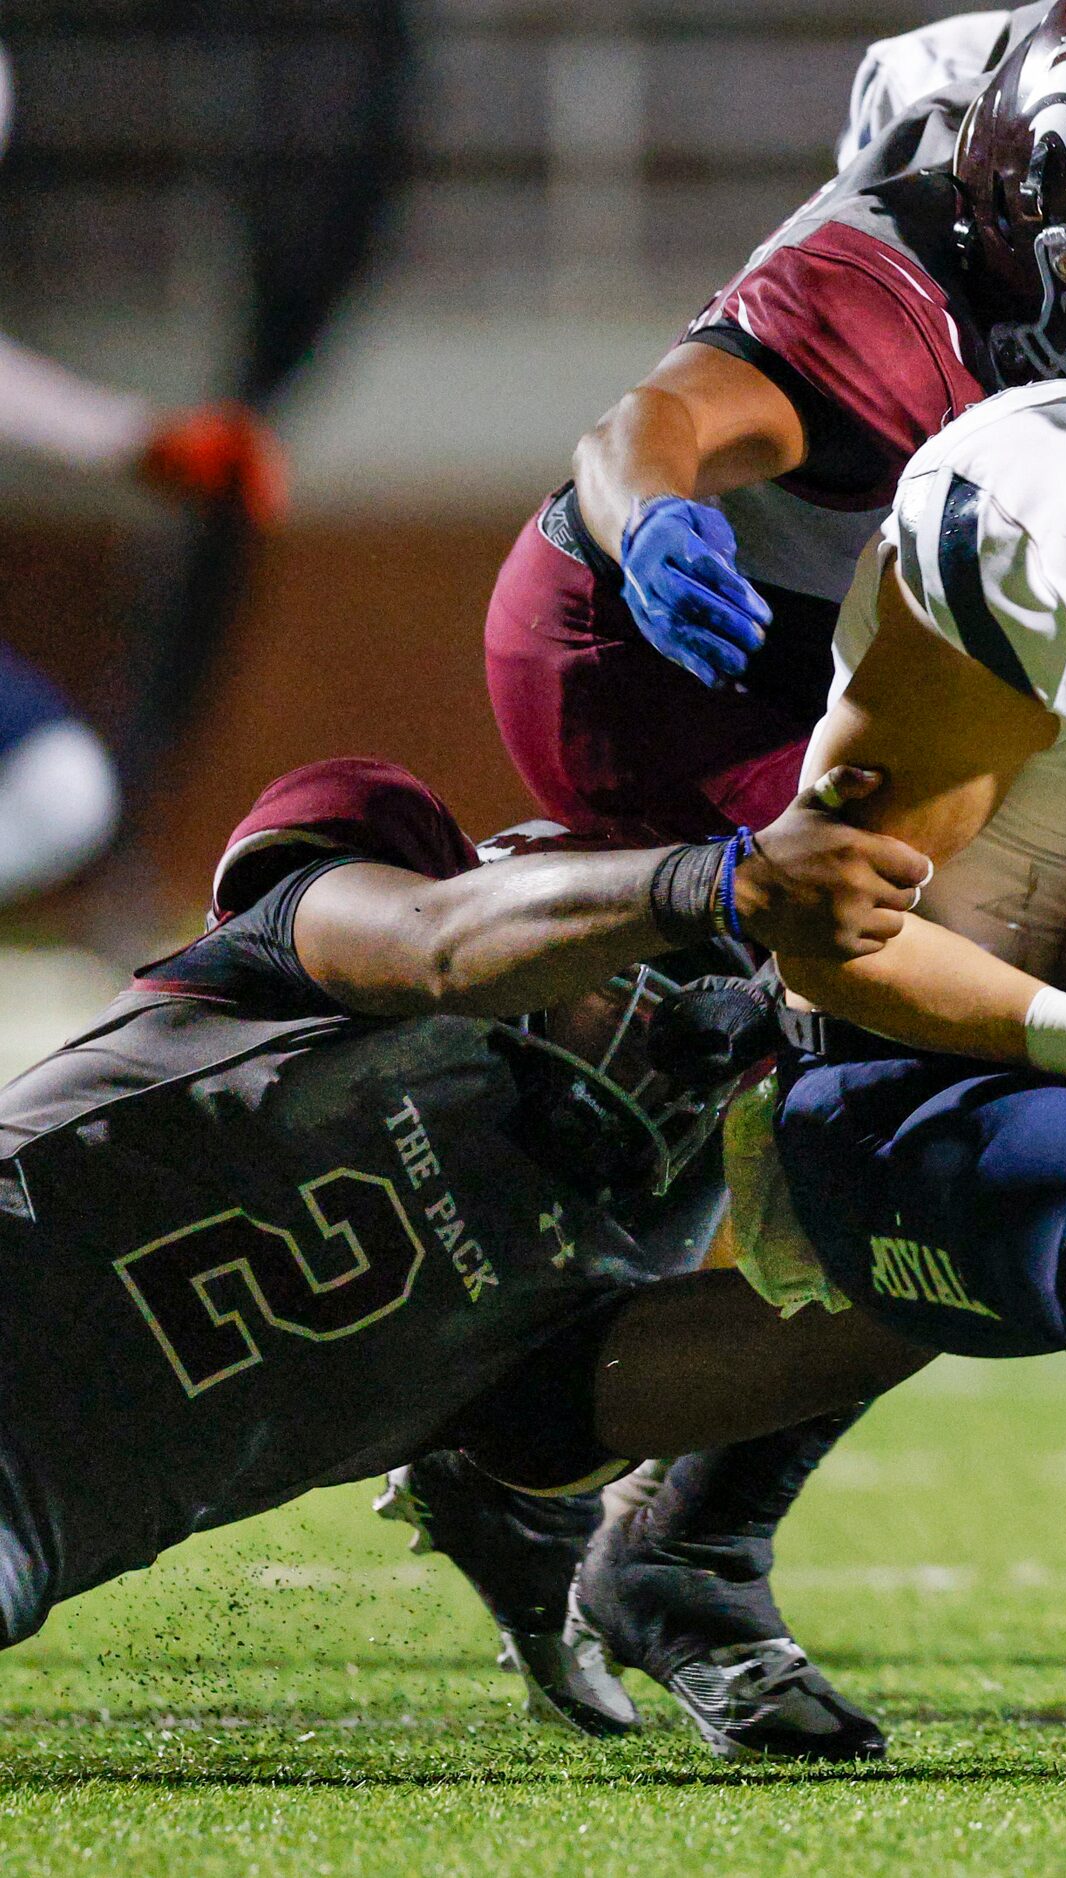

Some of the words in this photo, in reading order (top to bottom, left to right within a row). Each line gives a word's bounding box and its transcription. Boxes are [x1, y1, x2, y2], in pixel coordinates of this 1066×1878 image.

[112, 1166, 426, 1399] 2
[384, 1094, 441, 1190] THE
[424, 1191, 500, 1303] PACK
